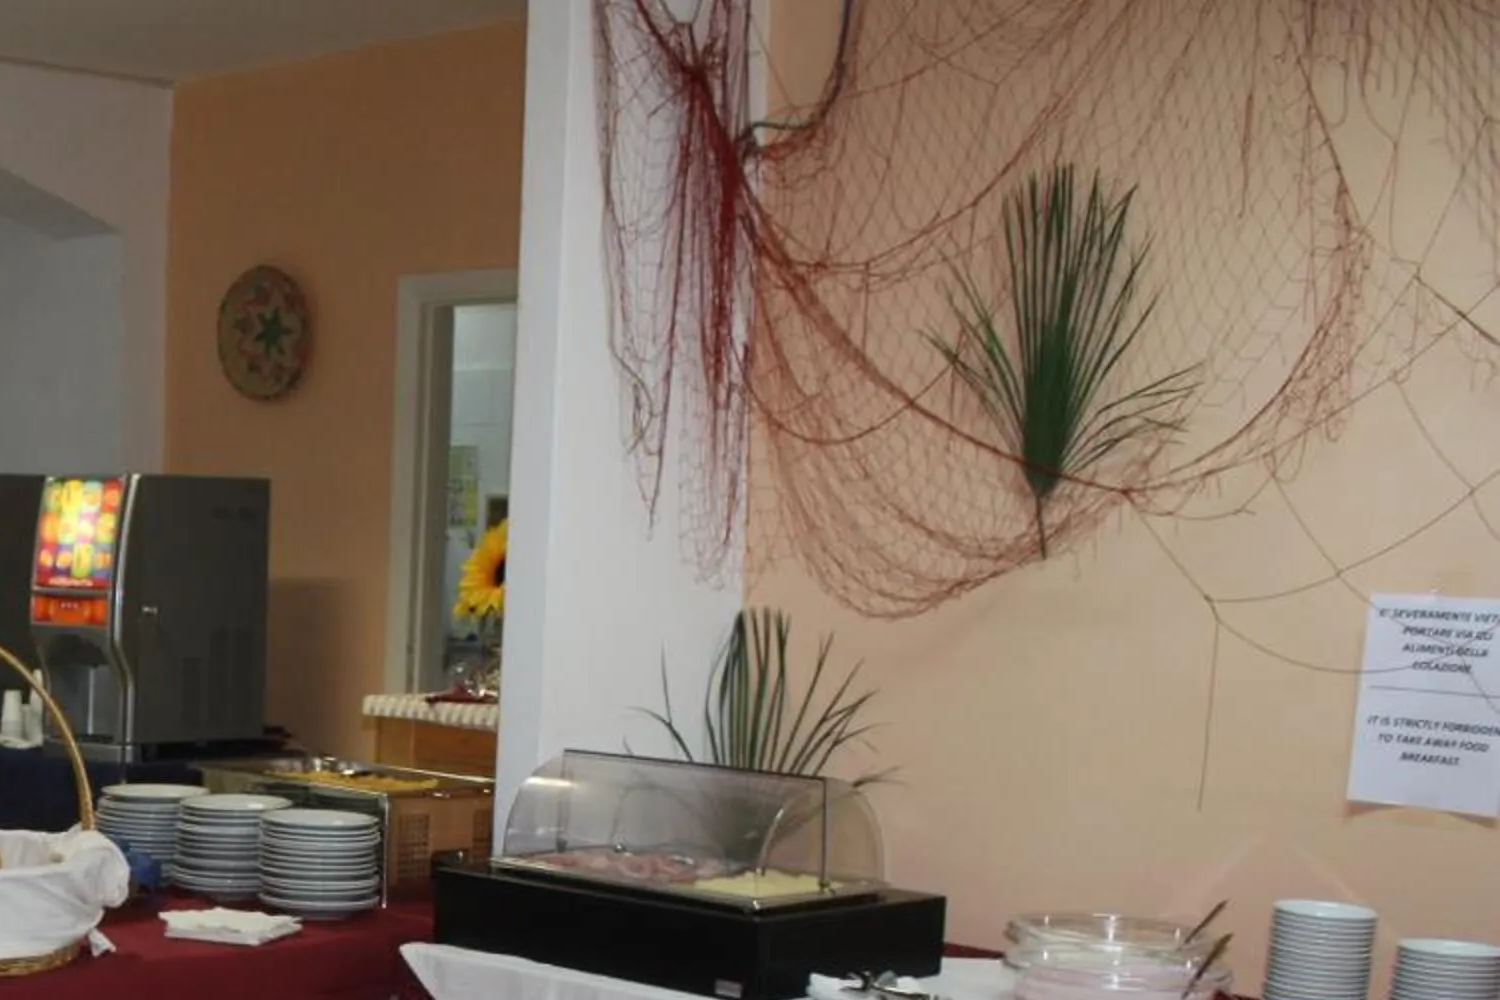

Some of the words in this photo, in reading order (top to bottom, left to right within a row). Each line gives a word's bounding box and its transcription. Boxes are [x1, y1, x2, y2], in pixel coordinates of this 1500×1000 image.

[1402, 626, 1453, 640] PORTARE
[1455, 630, 1473, 640] VIA
[1367, 714, 1379, 726] IT
[1380, 716, 1391, 727] IS
[1393, 717, 1440, 731] STRICTLY
[1378, 733, 1393, 744] TO
[1396, 734, 1423, 746] TAKE
[1458, 739, 1490, 753] FOOD
[1399, 751, 1460, 767] BREAKFAST
